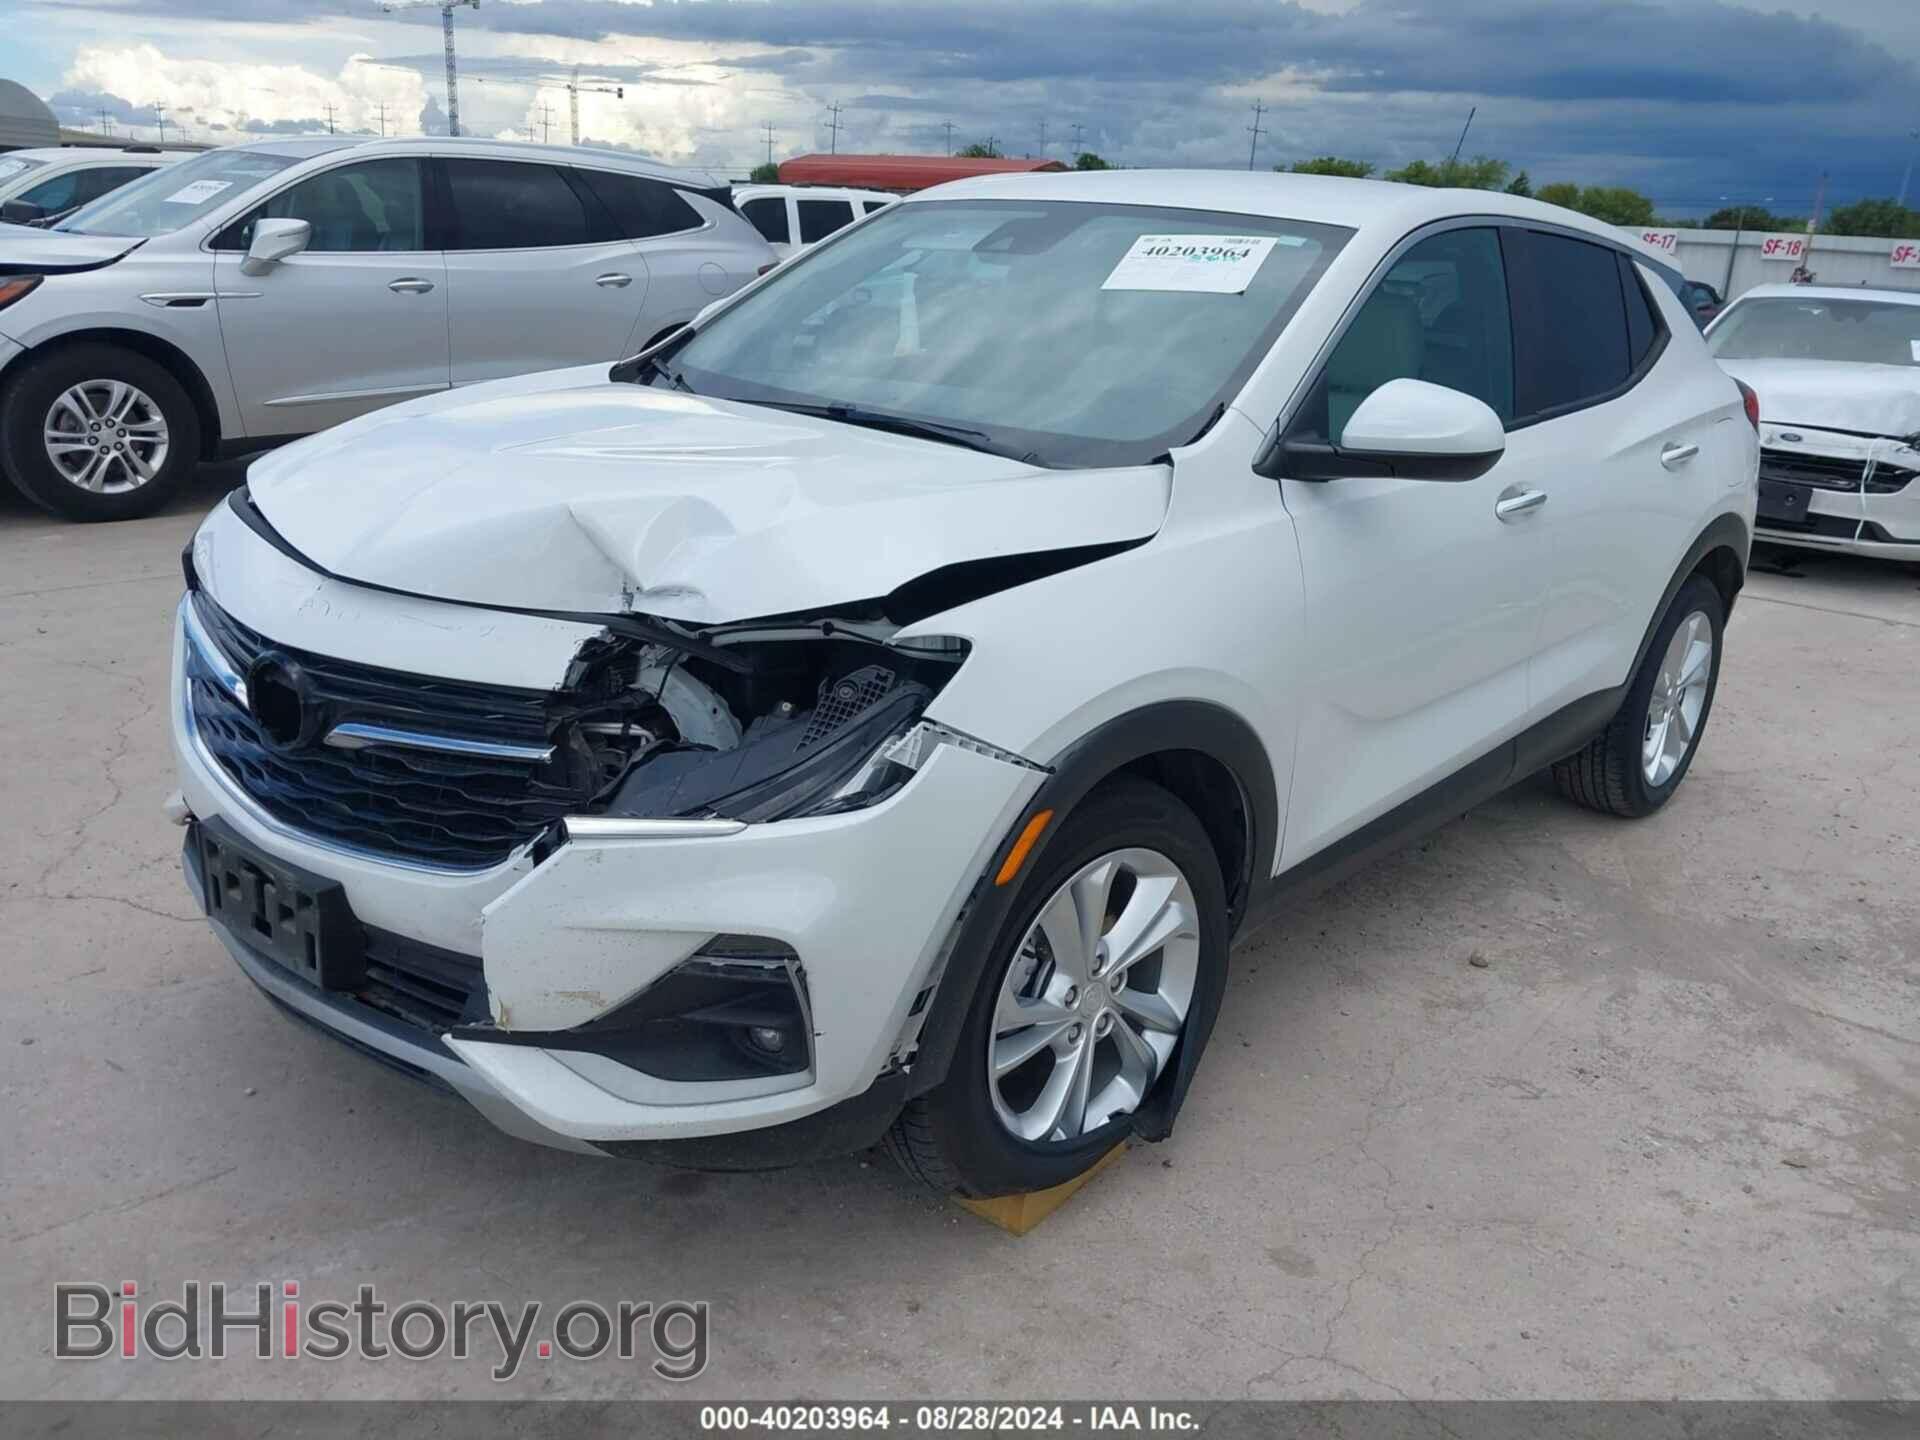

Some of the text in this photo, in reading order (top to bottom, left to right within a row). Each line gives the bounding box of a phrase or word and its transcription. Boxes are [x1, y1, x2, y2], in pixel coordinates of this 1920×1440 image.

[1142, 245, 1251, 258] 40203964
[1763, 239, 1802, 256] SF-18
[1893, 246, 1920, 263] SF-
